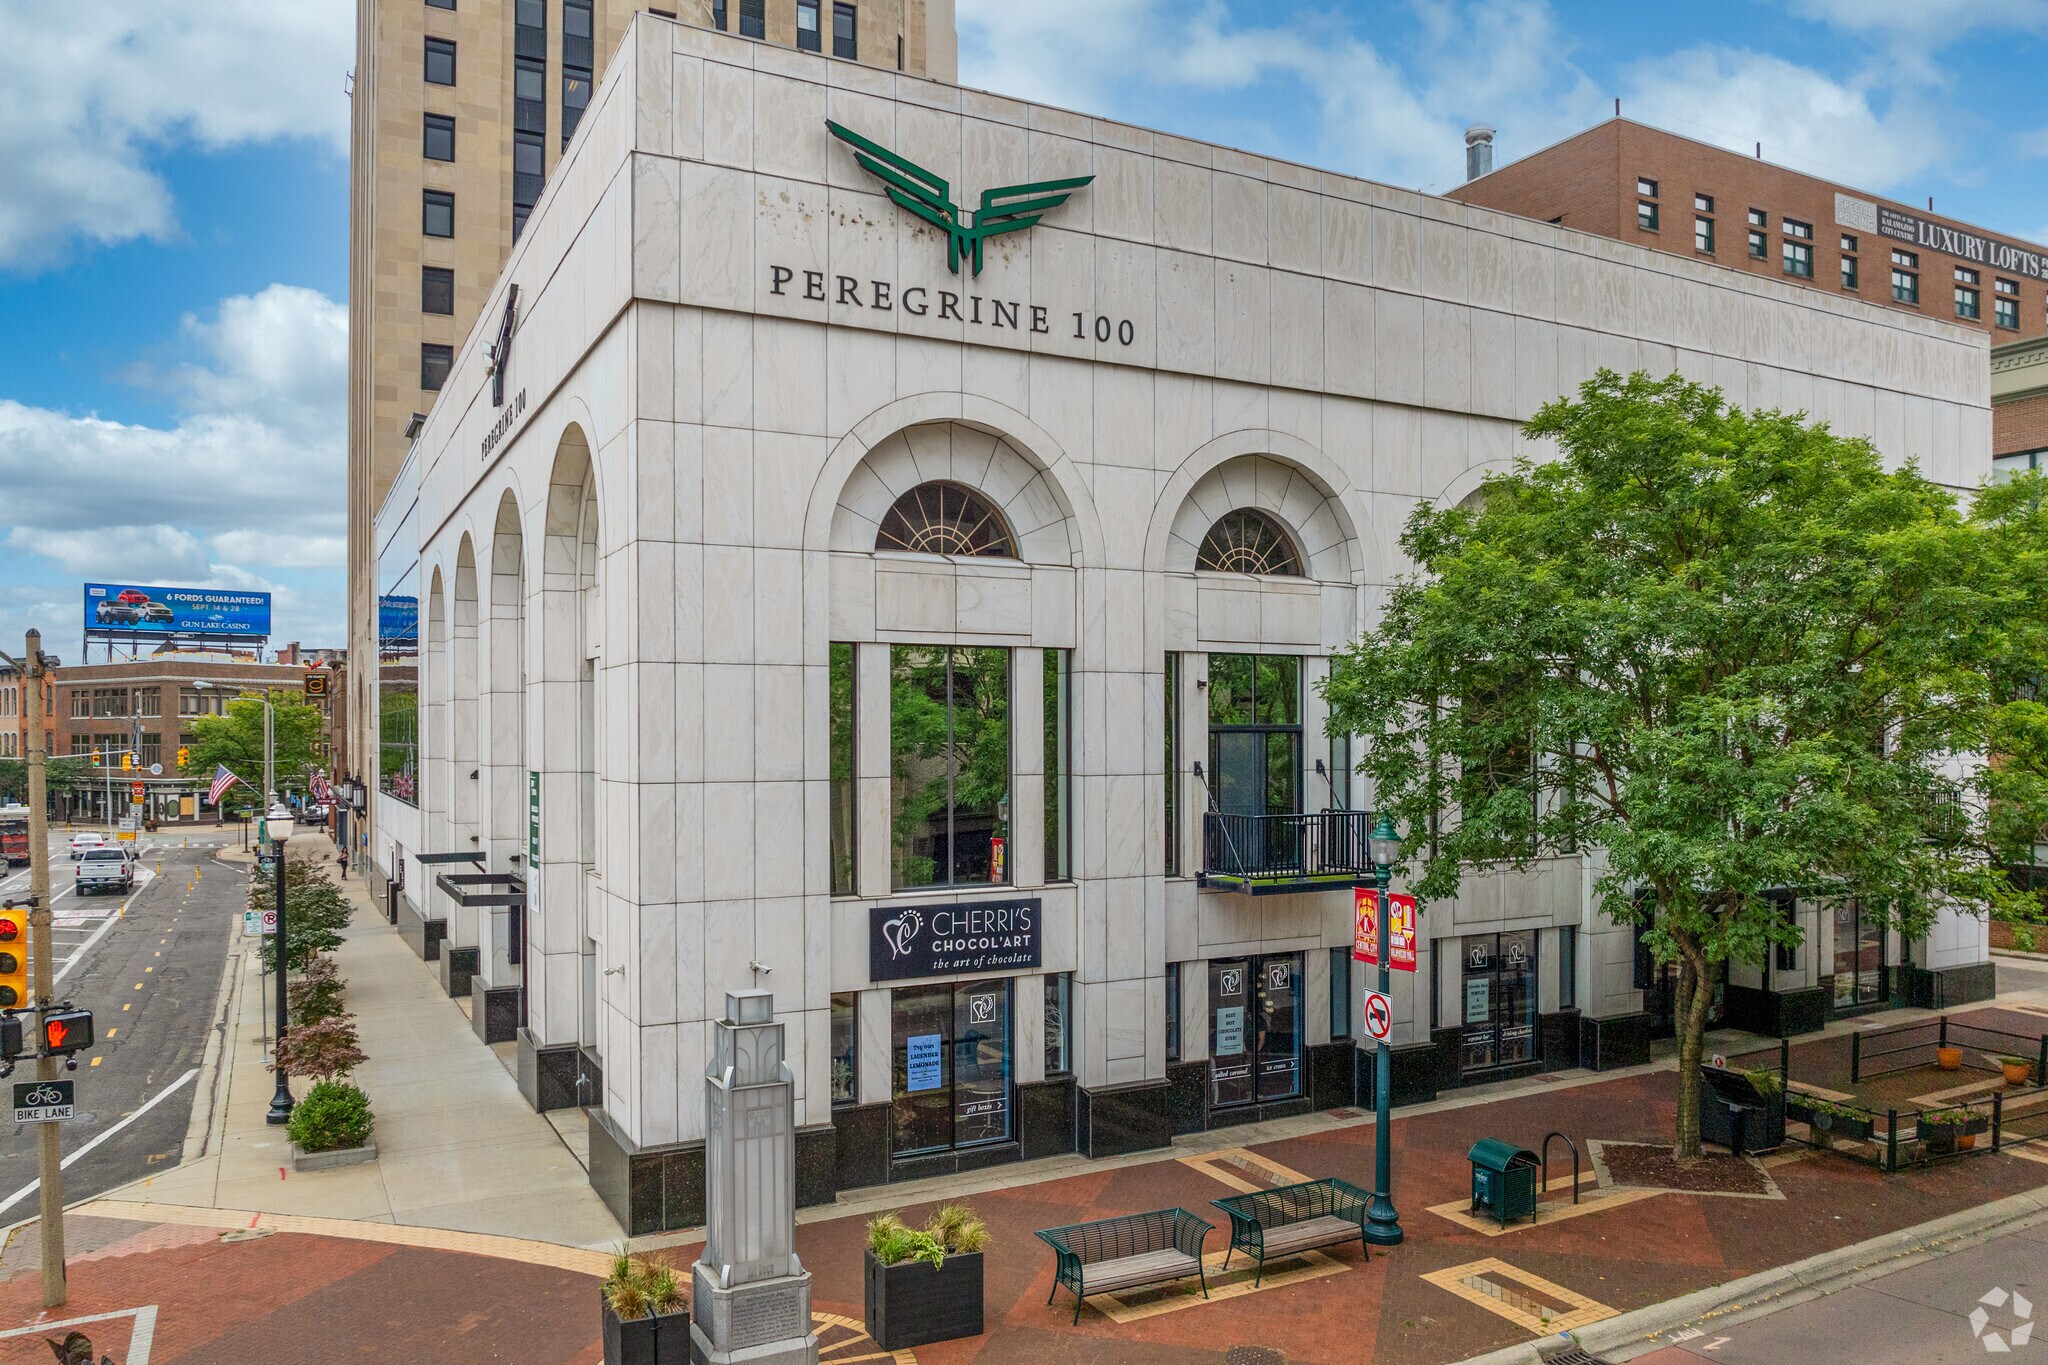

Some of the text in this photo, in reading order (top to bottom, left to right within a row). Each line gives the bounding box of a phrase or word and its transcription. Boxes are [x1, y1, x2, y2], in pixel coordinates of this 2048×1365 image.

[1838, 197, 1874, 218] SPECIAL
[1838, 210, 1874, 230] PRICING
[1882, 216, 1915, 233] KALAMAZOO
[1882, 226, 1914, 242] CITY CENTRE
[1918, 221, 2039, 277] LUXURY LOFTS
[770, 264, 1135, 346] PEREGRINE 100
[481, 386, 527, 462] PEREGRINE 100
[174, 594, 203, 602] FORDS
[205, 595, 264, 604] GUARANTEED!
[181, 620, 200, 628] GUN
[221, 622, 250, 630] CASINO
[932, 908, 1031, 936] CHERRI'S
[932, 934, 1031, 952] CHOCOL'ART
[933, 952, 1032, 969] the art of chocolate
[910, 1060, 940, 1069] LEMONADE
[1214, 1068, 1248, 1078] salted caramel
[17, 1106, 71, 1120] BIKE LANE
[966, 1104, 976, 1114] gift
